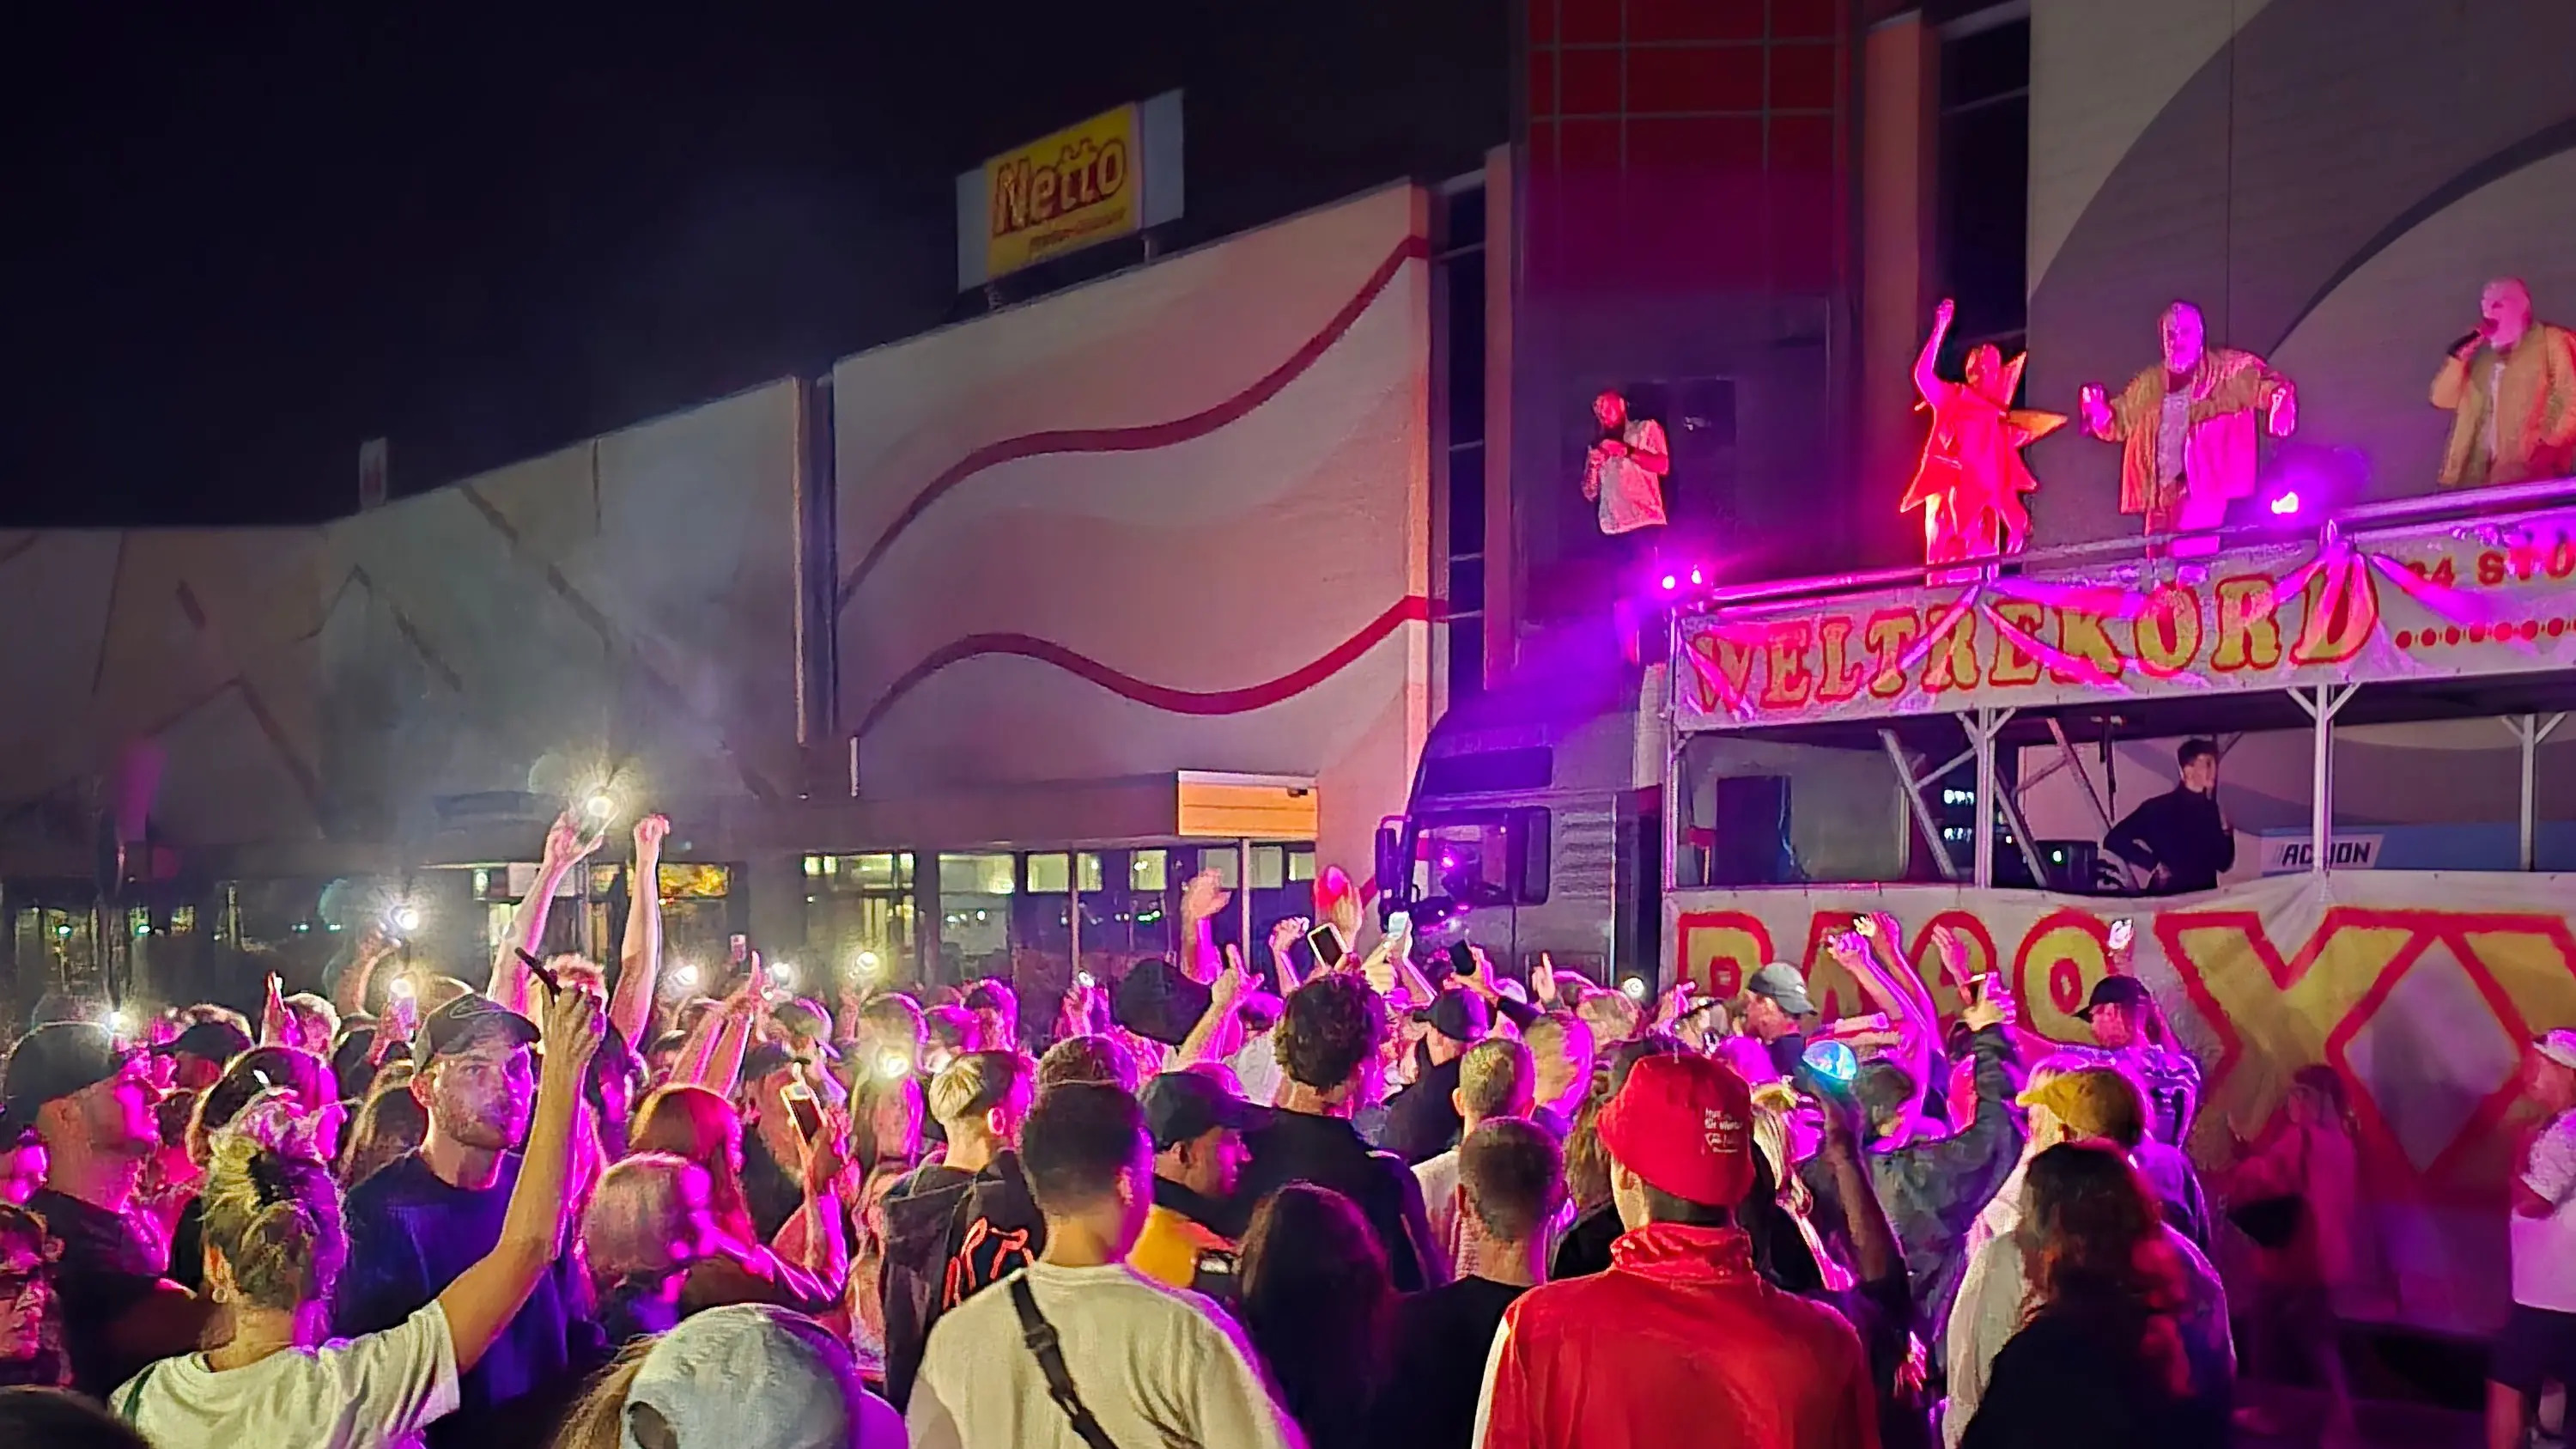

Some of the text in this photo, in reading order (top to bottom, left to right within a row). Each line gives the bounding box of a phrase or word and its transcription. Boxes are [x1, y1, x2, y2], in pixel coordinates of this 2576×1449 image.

[991, 136, 1127, 239] Netto
[1692, 560, 2379, 715] WELTREKORD
[2281, 842, 2371, 868] ACION
